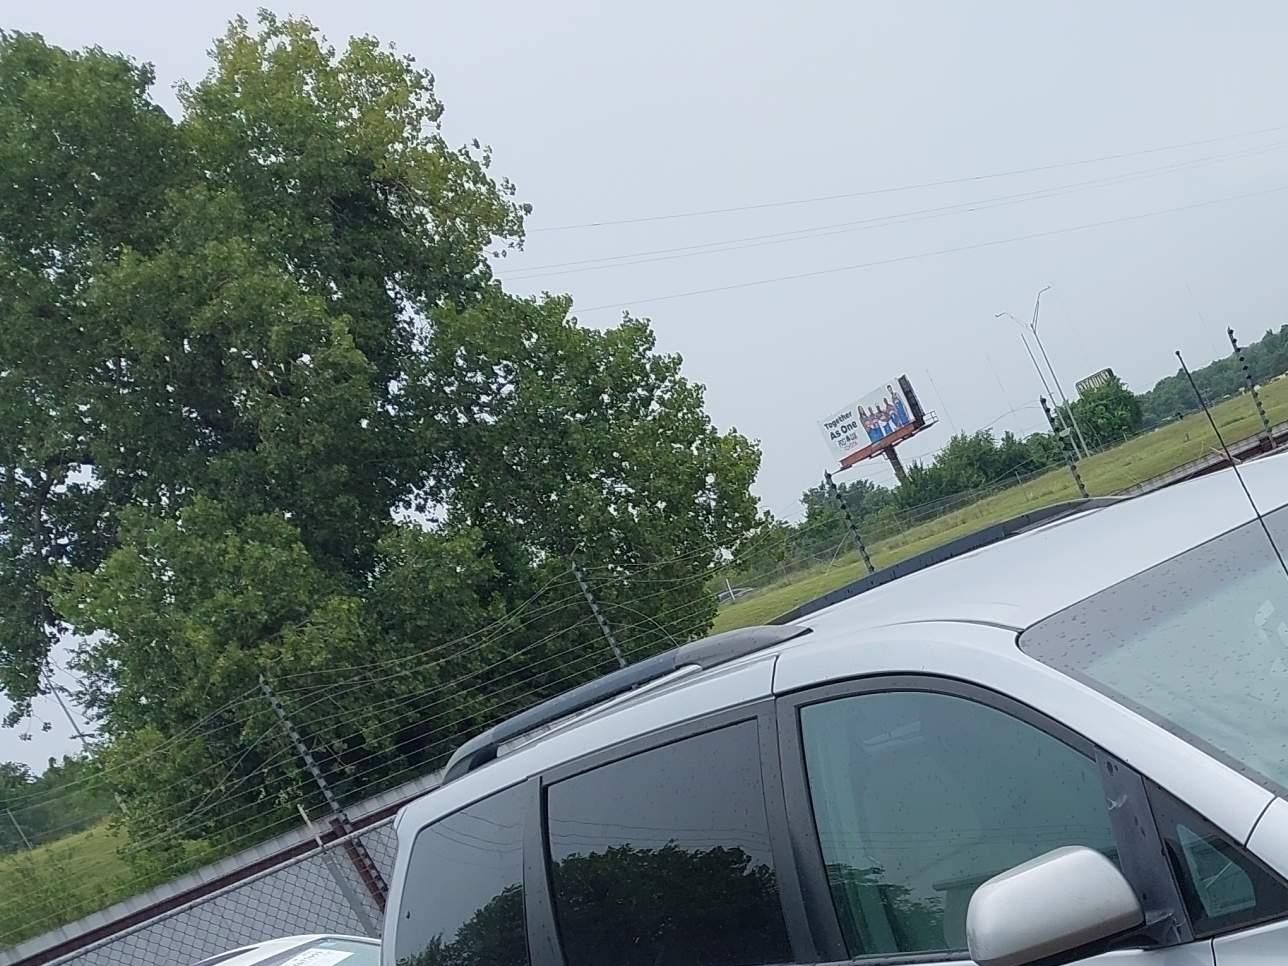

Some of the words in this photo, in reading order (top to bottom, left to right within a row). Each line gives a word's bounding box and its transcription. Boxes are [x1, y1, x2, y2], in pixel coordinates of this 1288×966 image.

[824, 410, 852, 430] Together
[830, 429, 842, 441] As
[840, 420, 858, 434] One
